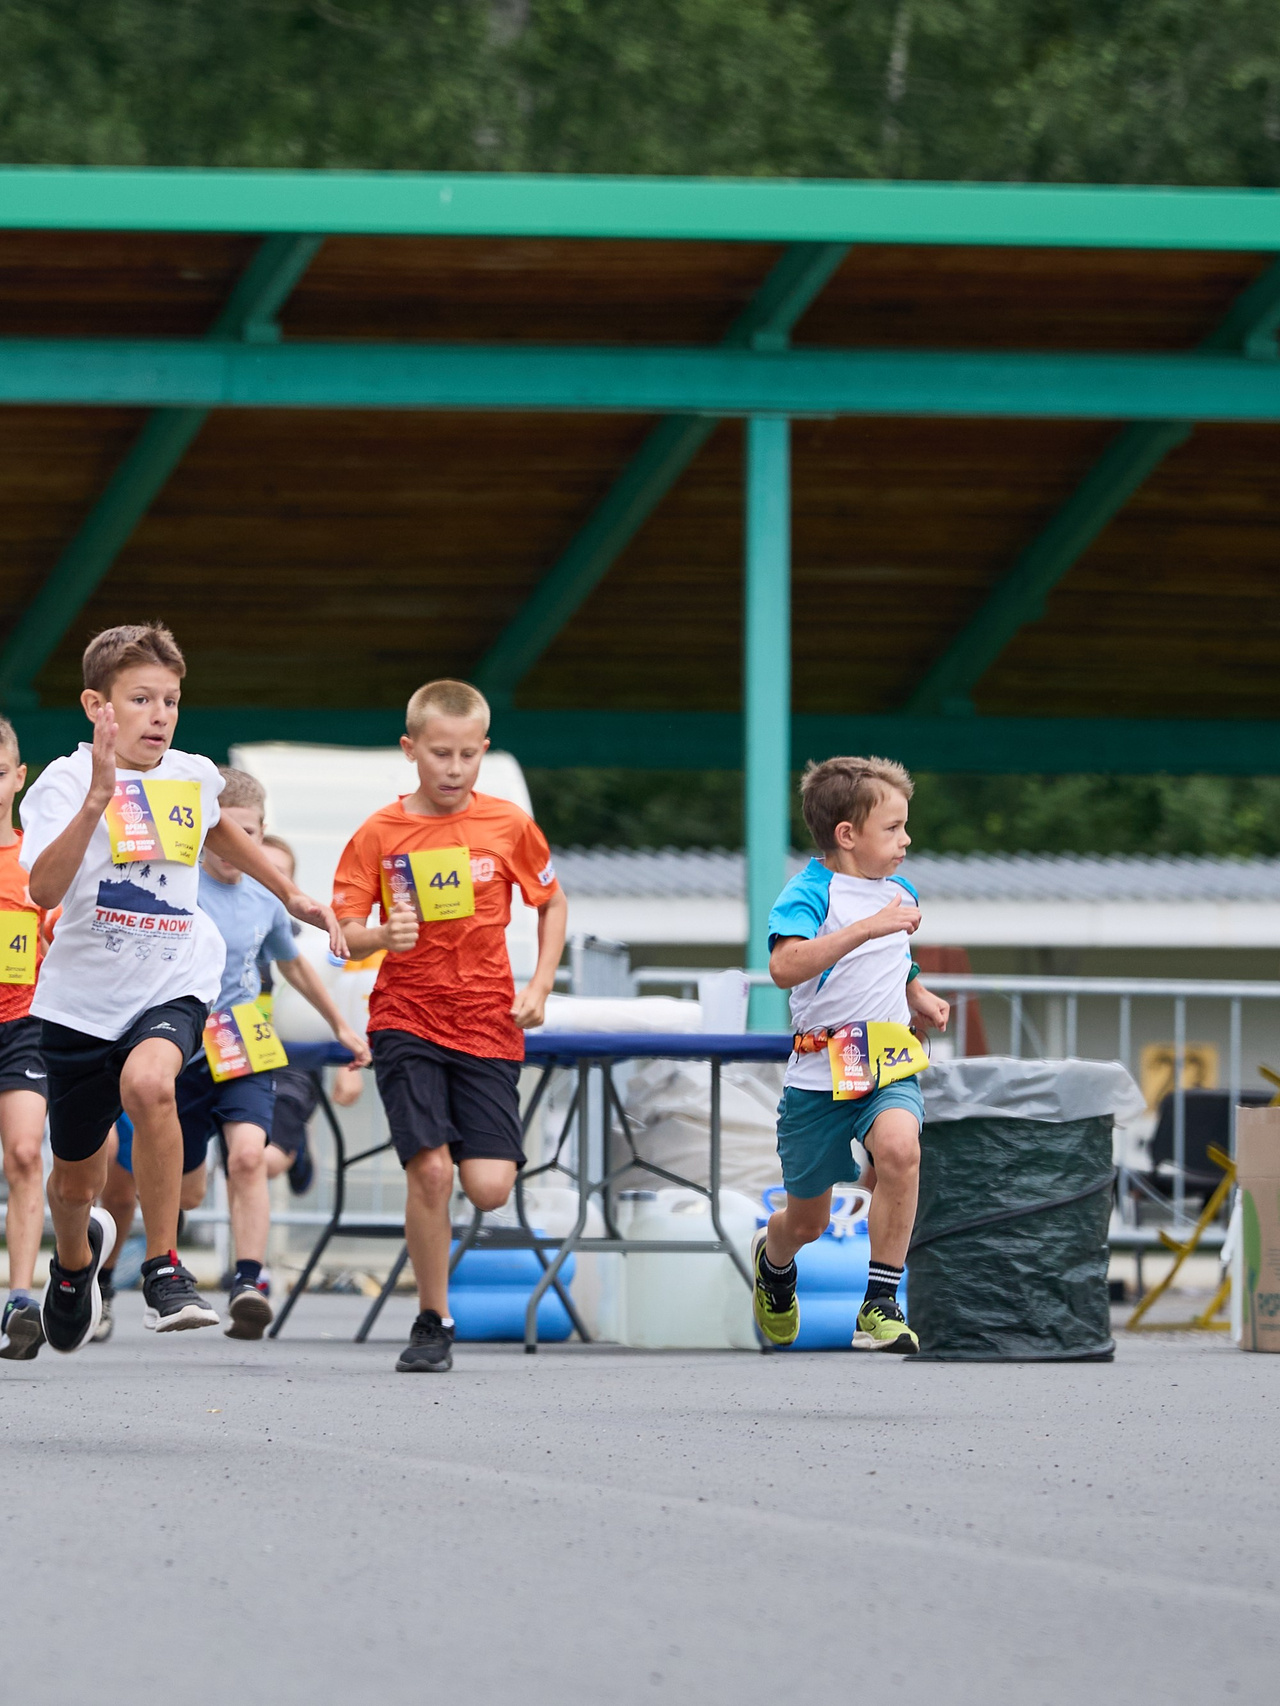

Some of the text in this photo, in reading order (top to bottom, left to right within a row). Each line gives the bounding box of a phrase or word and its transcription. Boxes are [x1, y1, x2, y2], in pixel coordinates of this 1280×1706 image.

[168, 805, 195, 829] 43
[429, 870, 461, 891] 44
[95, 908, 137, 927] TIME
[139, 917, 156, 930] IS
[158, 919, 194, 933] NOW!
[9, 934, 28, 953] 41
[253, 1022, 272, 1042] 33
[882, 1047, 914, 1067] 34
[838, 1080, 854, 1091] 28
